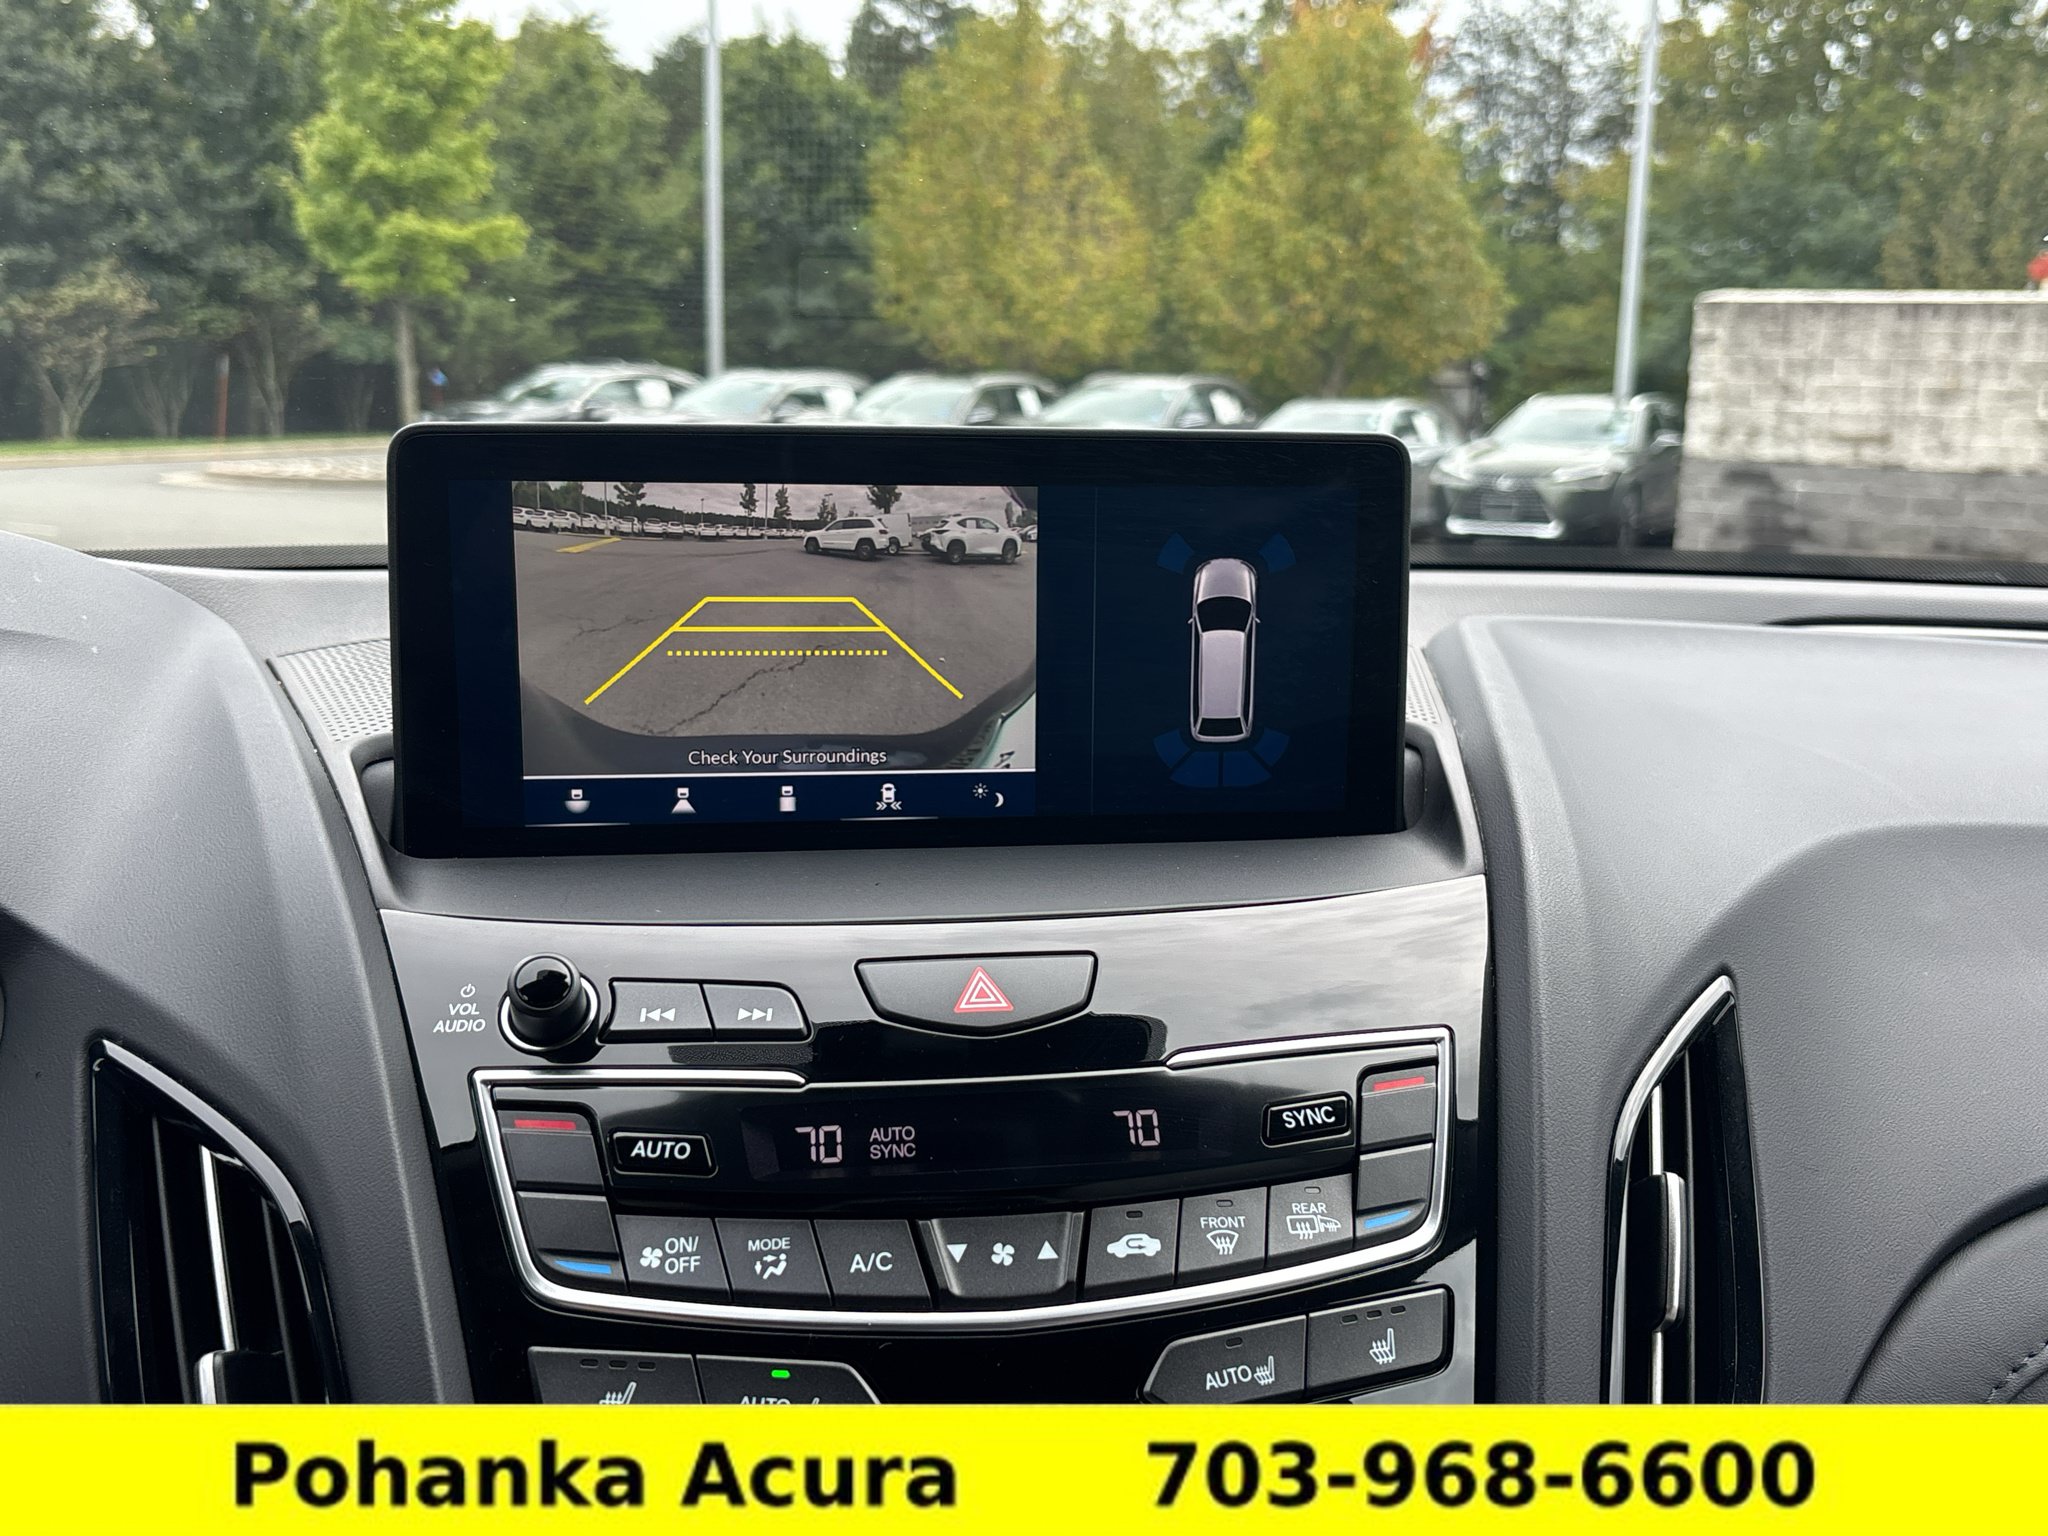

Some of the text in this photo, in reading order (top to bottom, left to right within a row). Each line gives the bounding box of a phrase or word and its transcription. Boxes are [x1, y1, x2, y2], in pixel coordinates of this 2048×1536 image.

[688, 748, 887, 766] Check Your Surroundings
[449, 1003, 480, 1016] VOL
[432, 1018, 486, 1034] AUDIO
[1282, 1105, 1336, 1129] SYNC
[869, 1126, 915, 1143] AUTO
[1112, 1108, 1160, 1147] 70
[630, 1140, 691, 1160] AUTO
[794, 1125, 843, 1164] 70
[869, 1142, 916, 1159] SYNC
[1291, 1202, 1327, 1214] REAR
[1200, 1215, 1246, 1229] FRONT
[664, 1236, 699, 1254] ON/
[748, 1237, 791, 1251] MODE
[664, 1255, 700, 1274] OFF
[850, 1252, 893, 1273] A/C
[1205, 1364, 1252, 1391] AUTO
